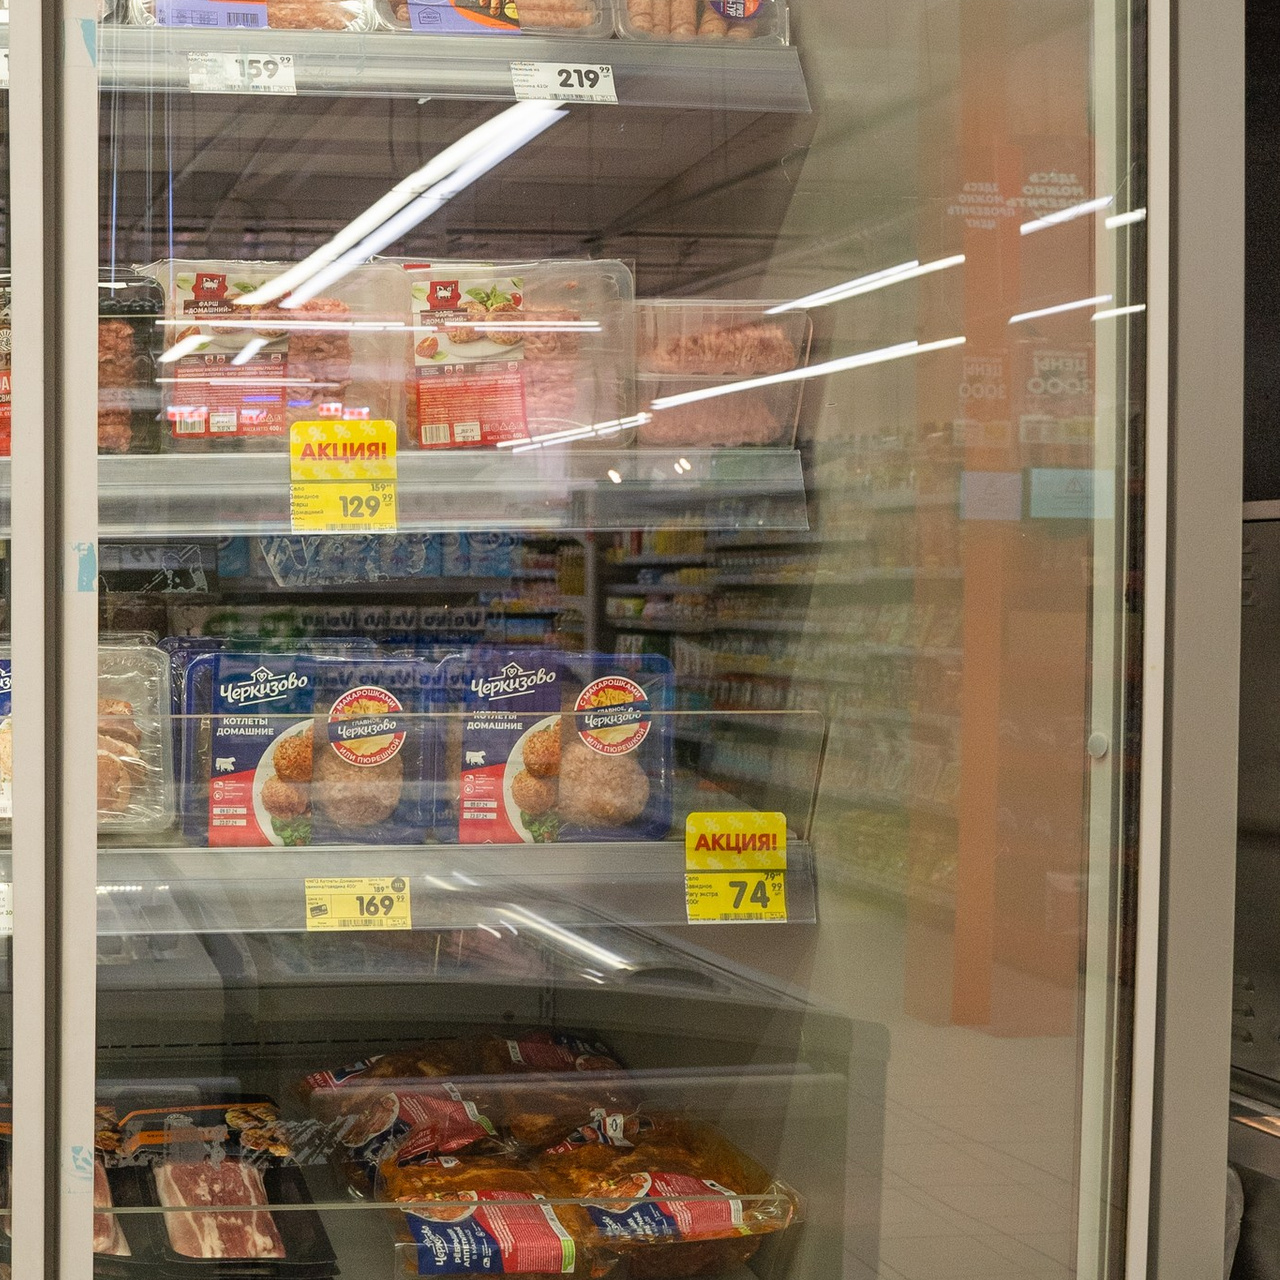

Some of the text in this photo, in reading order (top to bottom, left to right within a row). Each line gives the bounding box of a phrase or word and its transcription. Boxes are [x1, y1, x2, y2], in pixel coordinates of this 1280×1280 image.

[235, 56, 291, 79] 159 99
[558, 69, 600, 89] 219
[300, 442, 387, 464] АКЦИЯ!
[339, 494, 393, 518] 129 99
[220, 671, 308, 704] Черкизово
[471, 667, 556, 698] Черкизово
[583, 678, 642, 699] МАКАРОШКАМИ
[337, 688, 397, 711] МАКАРОШКАМИ
[216, 727, 274, 737] ДОМАШНИЕ
[223, 717, 268, 726] КОТЛЕТЫ
[337, 718, 397, 739] Черкизово
[467, 722, 523, 730] ДОМАШНИЕ
[357, 737, 401, 764] ПЮРЕШКОЙ
[604, 727, 647, 754] ПЮРЕШКОЙ
[695, 833, 777, 854] АКЦИЯ!
[356, 895, 394, 916] 169
[729, 880, 783, 909] 74 99
